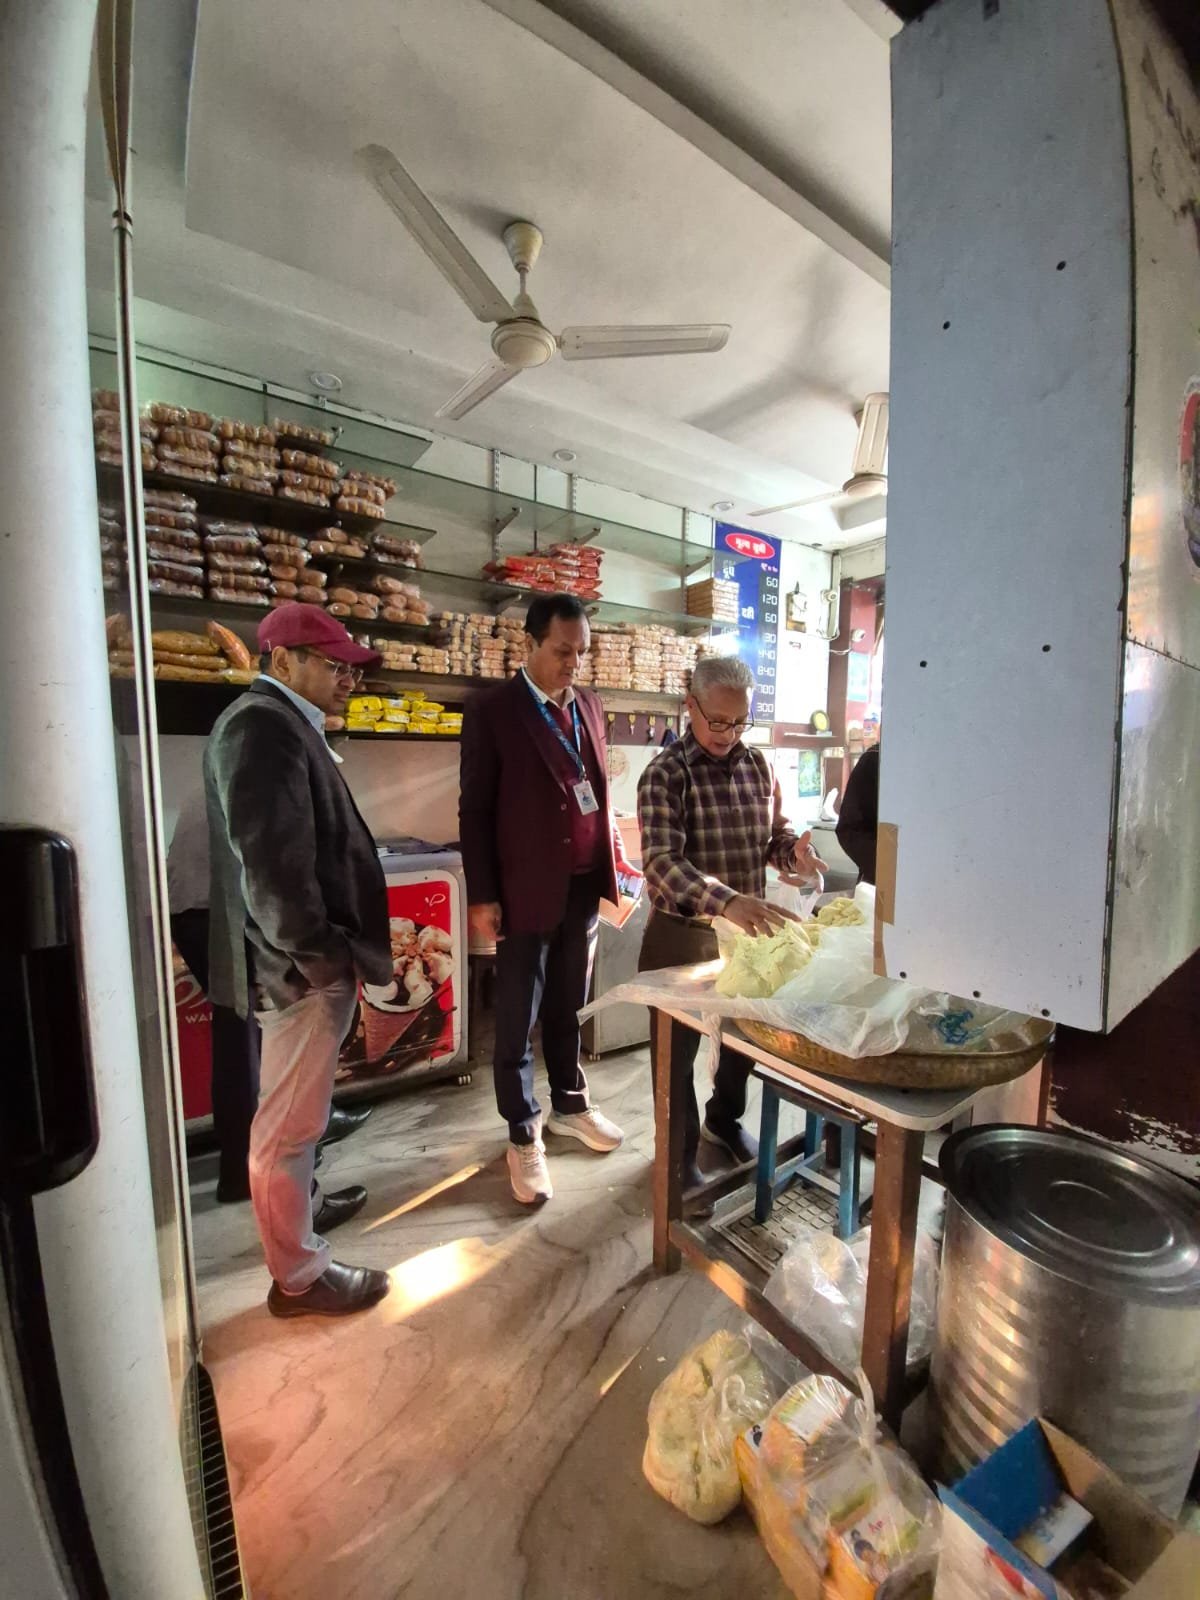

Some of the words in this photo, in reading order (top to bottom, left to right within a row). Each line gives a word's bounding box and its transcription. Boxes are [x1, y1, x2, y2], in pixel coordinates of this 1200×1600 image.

[766, 577, 778, 588] 60
[762, 594, 778, 606] 120
[765, 612, 777, 624] 60
[756, 702, 774, 713] 300
